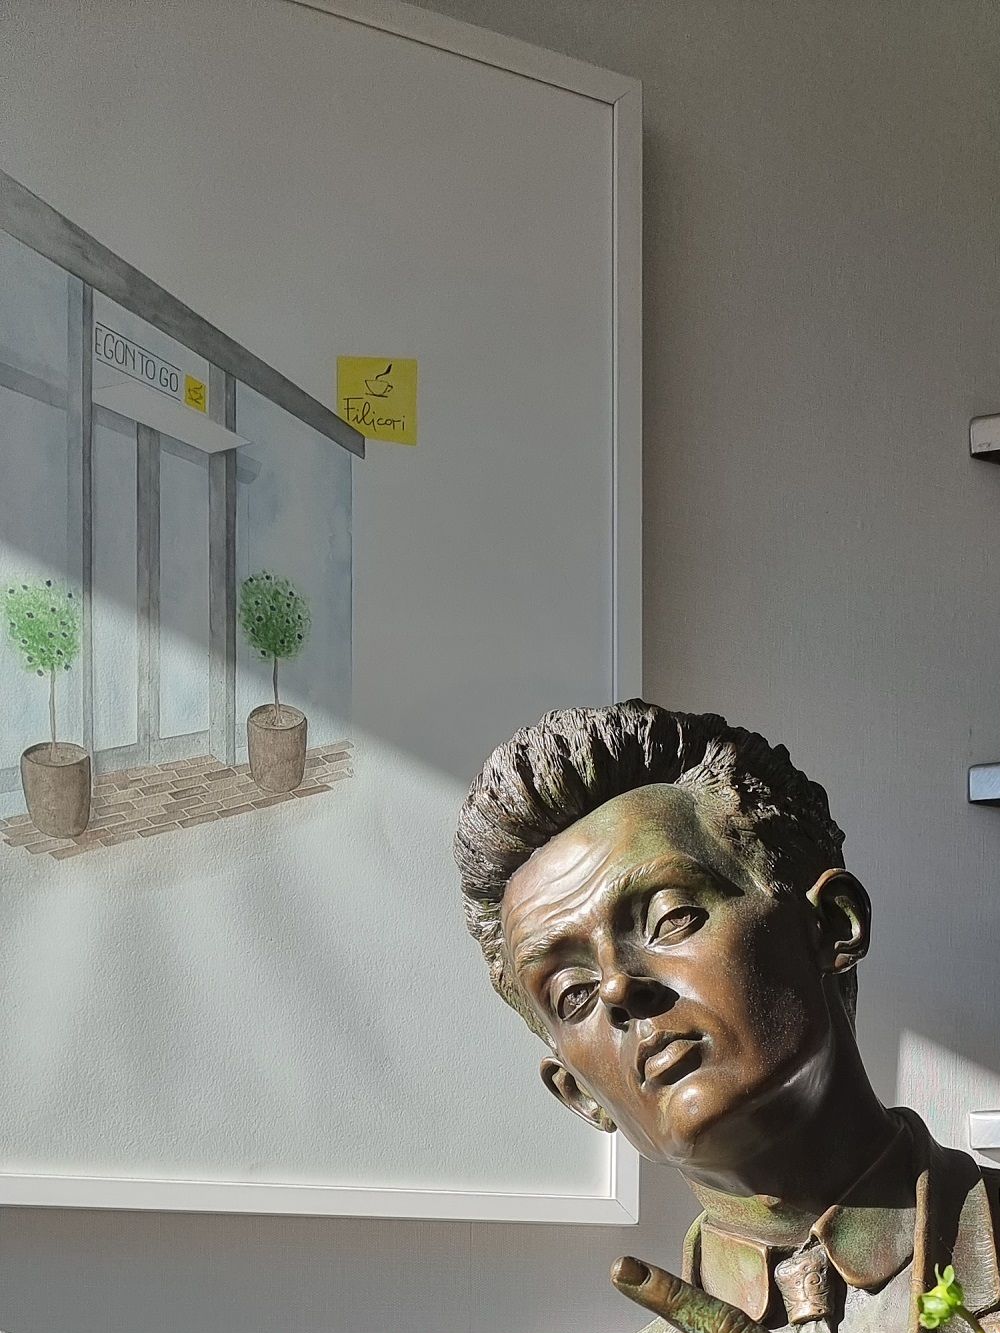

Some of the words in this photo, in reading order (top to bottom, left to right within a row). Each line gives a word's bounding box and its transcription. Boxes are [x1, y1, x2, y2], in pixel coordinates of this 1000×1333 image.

[95, 327, 135, 370] EGON
[138, 352, 156, 380] TO
[160, 367, 179, 392] GO
[343, 397, 405, 432] Filicori
